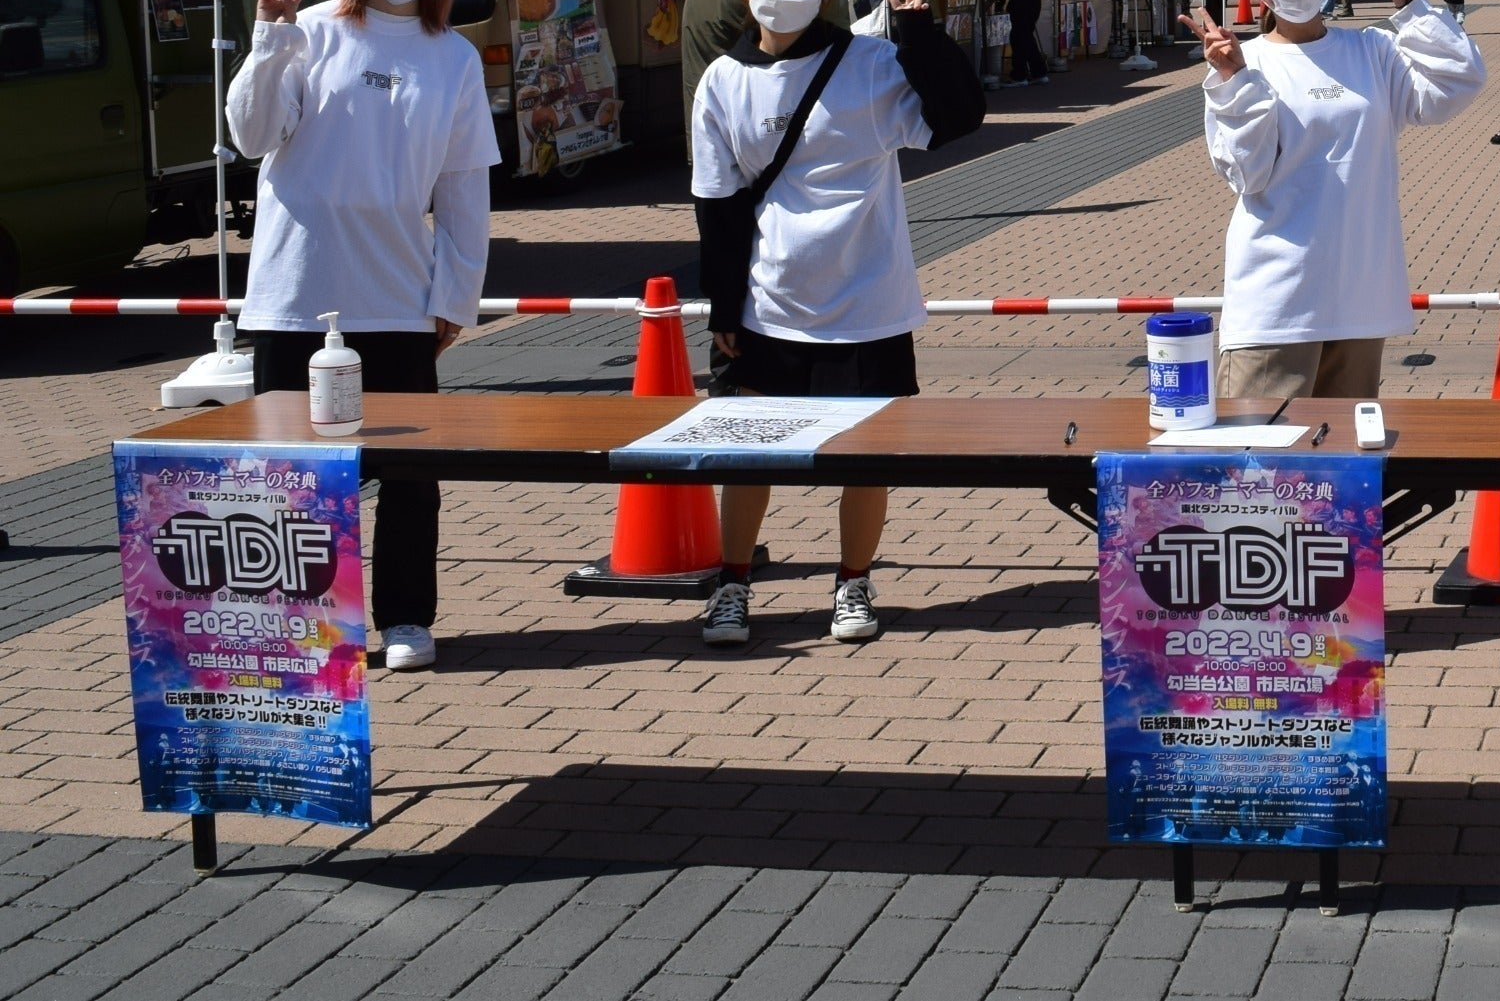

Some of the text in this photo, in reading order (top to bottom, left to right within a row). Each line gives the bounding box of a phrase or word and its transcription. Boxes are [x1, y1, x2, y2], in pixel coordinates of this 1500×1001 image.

[361, 71, 402, 89] TDF
[1308, 84, 1344, 99] TDF
[1150, 369, 1179, 387] 除菌
[157, 468, 317, 491] 全パフォーマーの祭典
[188, 491, 287, 504] 東北ダンスフェスティバル
[1147, 479, 1333, 501] 全パフォーマーの祭典
[1181, 503, 1298, 516] 東北ダンスフェスティバル
[152, 511, 332, 592] TDF
[1135, 522, 1349, 608] TDF
[157, 590, 336, 608] TOHOKU DANCE FESTIVAL
[183, 610, 319, 640] 2022.4.9 SAT
[1136, 609, 1349, 624] TOHOKU DANCE FESTIVAL
[1165, 630, 1326, 658] 2022.4.9 SAT
[187, 653, 319, 674] 勾当台公園 市民広場
[229, 674, 283, 689] 入場料 無料
[1167, 675, 1323, 694] 勾当台公園 市民広場
[165, 691, 342, 715] 伝統舞踊やストリートダンスなど
[1213, 697, 1278, 710] 入場料 無料
[1140, 716, 1352, 733] 伝統舞踊やストリートダンスなど
